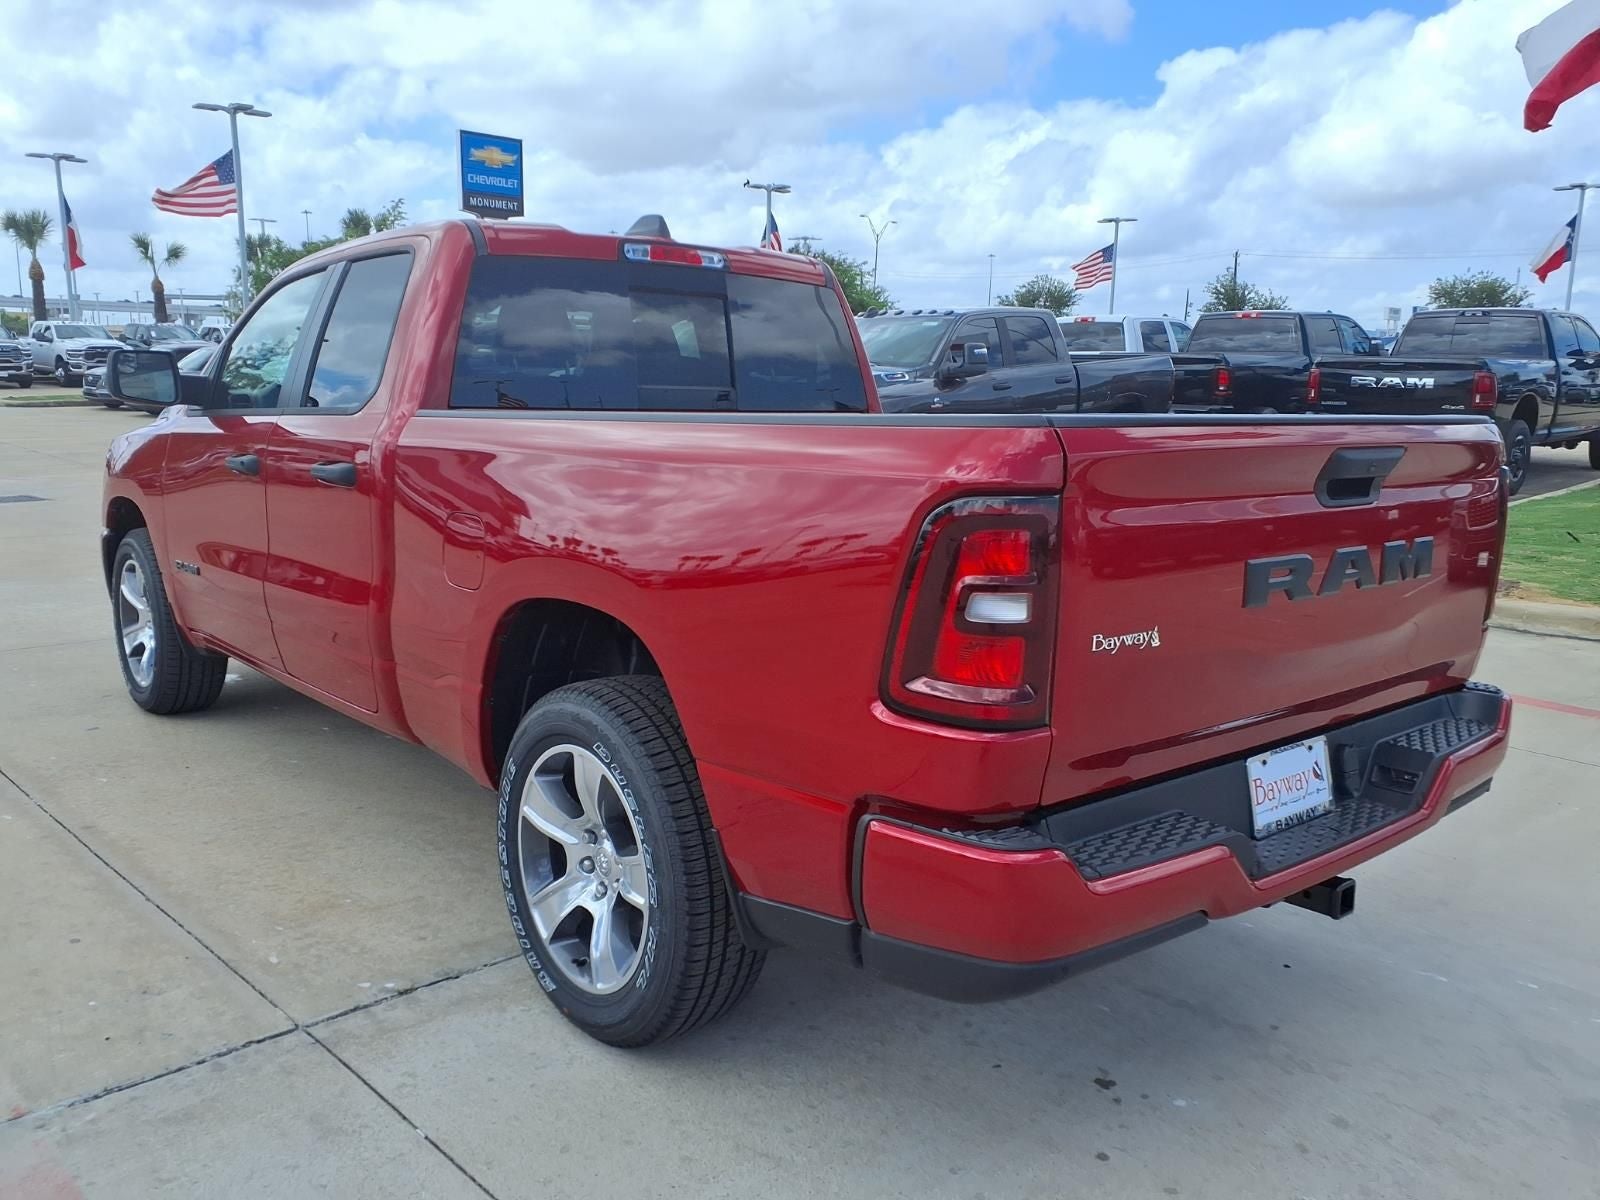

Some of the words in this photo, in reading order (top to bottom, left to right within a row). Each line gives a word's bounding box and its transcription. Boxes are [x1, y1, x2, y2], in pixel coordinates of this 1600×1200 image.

[467, 173, 518, 189] CHEVROLET
[469, 196, 518, 211] MONUMENT
[1351, 376, 1435, 389] RAM
[1241, 536, 1434, 608] RAM
[1091, 630, 1153, 655] Bayway
[1252, 769, 1312, 808] Bayway
[1275, 806, 1318, 831] BAYWAY
